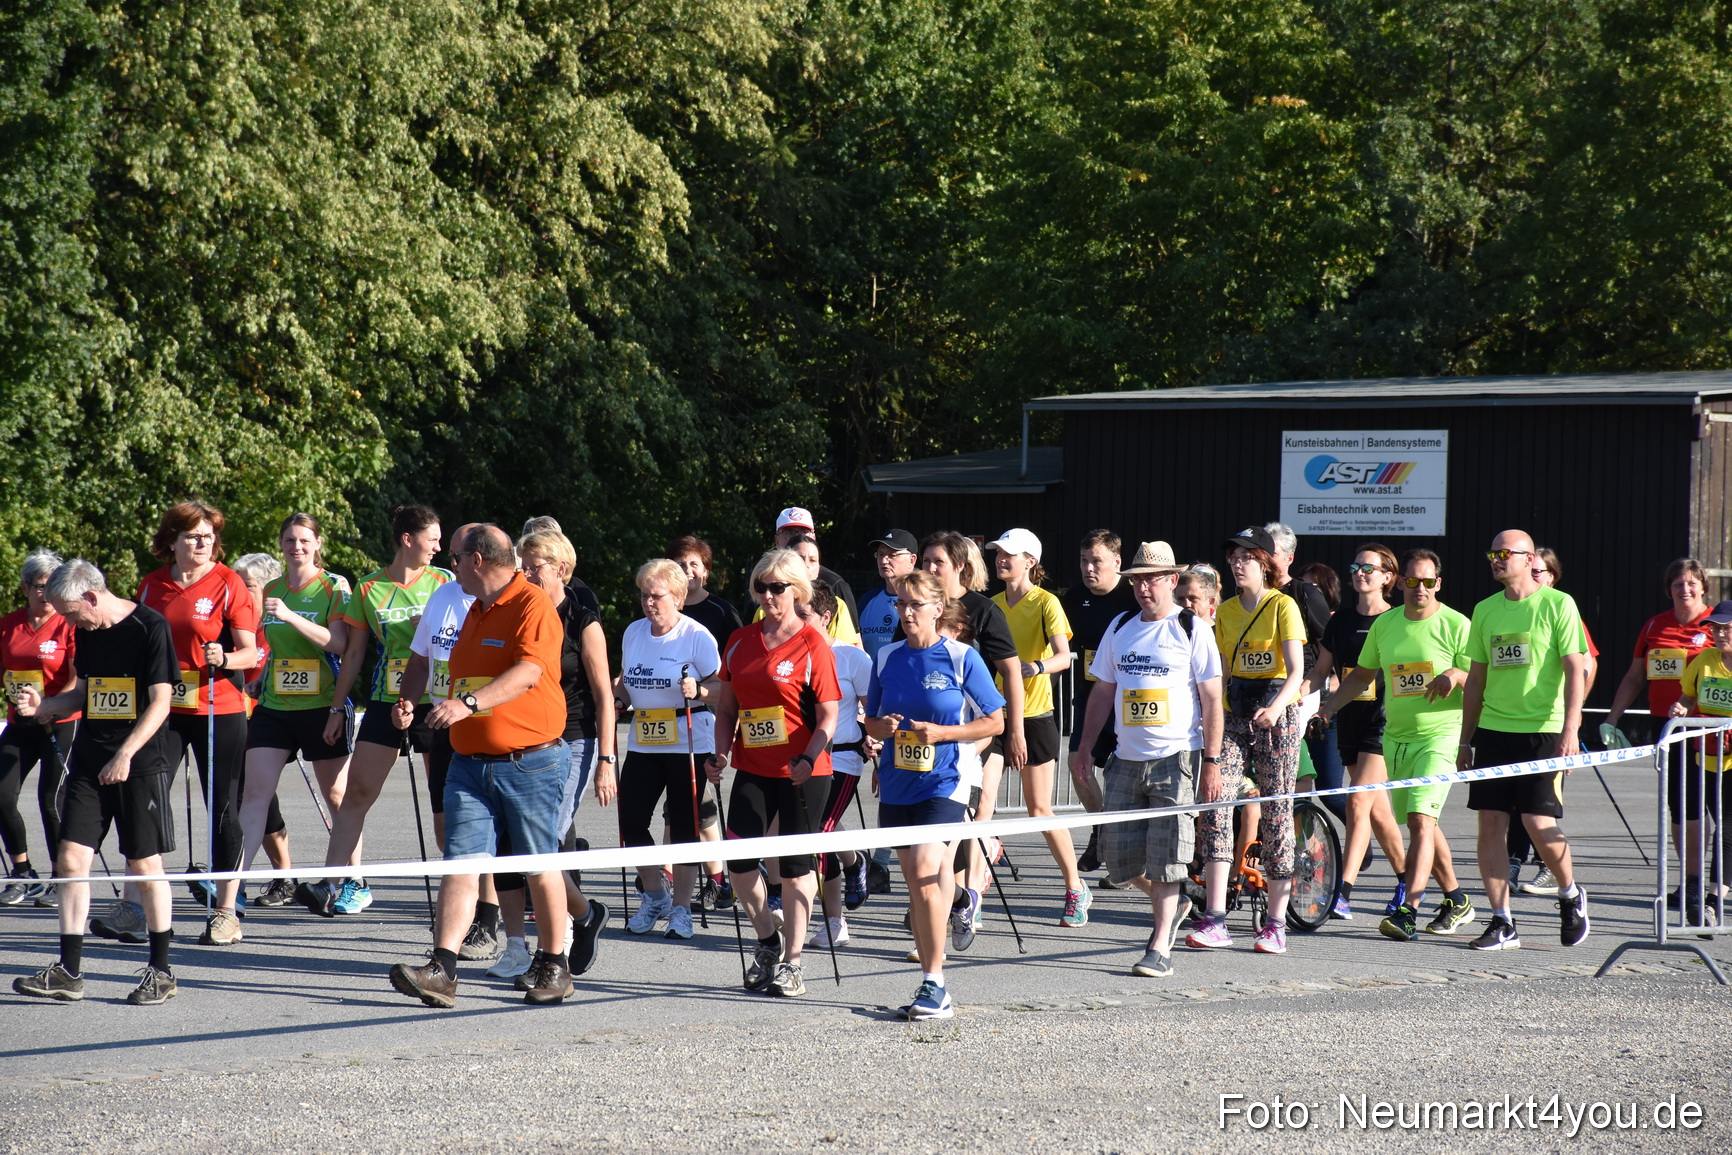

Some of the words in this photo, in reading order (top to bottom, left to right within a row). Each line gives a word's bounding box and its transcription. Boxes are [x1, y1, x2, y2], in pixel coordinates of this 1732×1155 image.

[1285, 437, 1359, 448] Kunsteisbahnen
[1367, 437, 1442, 450] Bandensysteme
[1317, 461, 1382, 484] AST
[1353, 485, 1402, 495] www.ast.at
[1297, 503, 1369, 514] Eisbahntechnik
[1372, 506, 1391, 514] vom
[1393, 503, 1426, 514] Besten
[1120, 650, 1151, 664] KÖNIG
[1241, 652, 1272, 666] 1629
[1497, 645, 1522, 659] 346
[627, 663, 654, 676] KÖNIG
[1117, 664, 1170, 675] Engineering
[1655, 659, 1677, 671] 364
[282, 671, 309, 685] 228
[624, 675, 672, 688] Engineering
[1400, 673, 1424, 688] 349
[92, 692, 128, 707] 1702
[1130, 702, 1158, 716] 979
[642, 722, 666, 736] 975
[748, 721, 775, 737] 358
[898, 744, 931, 760] 1960
